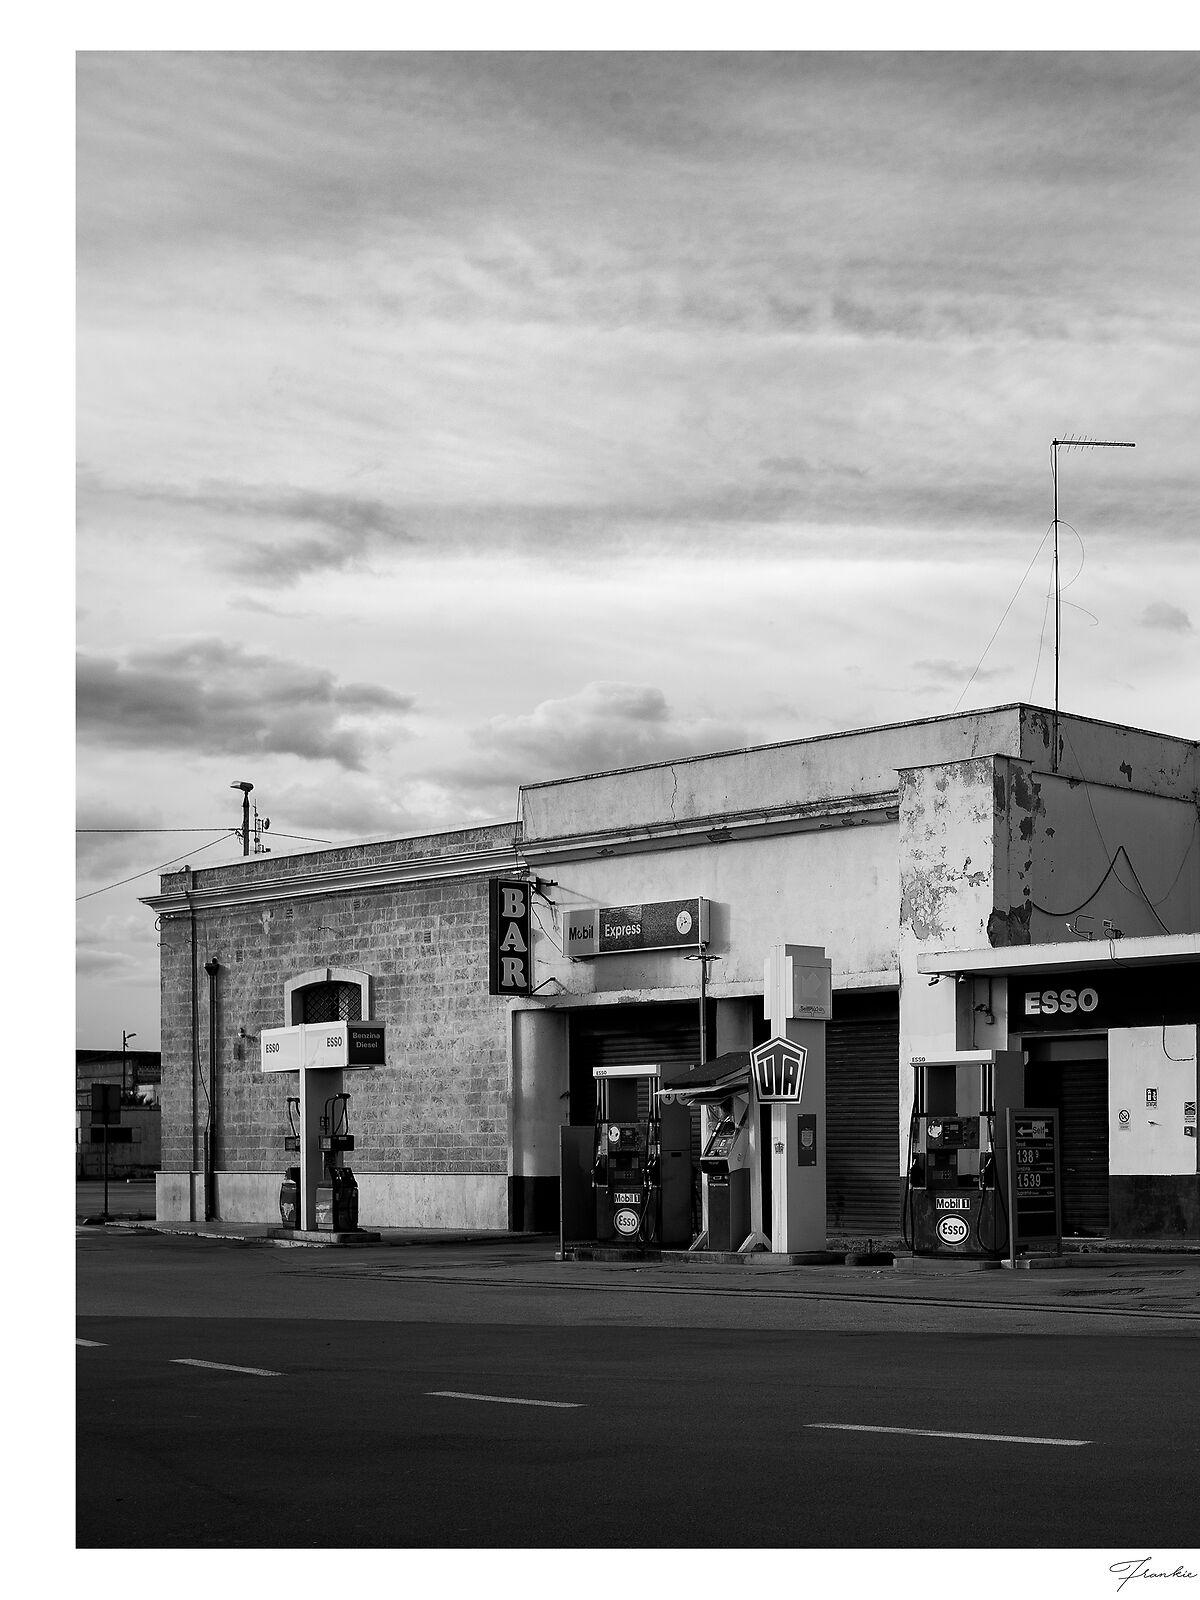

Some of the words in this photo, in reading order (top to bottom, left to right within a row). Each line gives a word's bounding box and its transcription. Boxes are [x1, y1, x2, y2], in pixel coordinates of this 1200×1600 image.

[568, 925, 594, 941] Mobil
[604, 922, 641, 940] Express
[500, 887, 528, 988] BAR
[1024, 987, 1099, 1015] ESSO
[352, 1031, 381, 1039] Benzina
[326, 1036, 342, 1047] ESSO
[265, 1043, 280, 1053] ESSO
[1032, 1126, 1045, 1135] Self
[1017, 1173, 1041, 1187] 1539
[936, 1198, 961, 1209] Mobil
